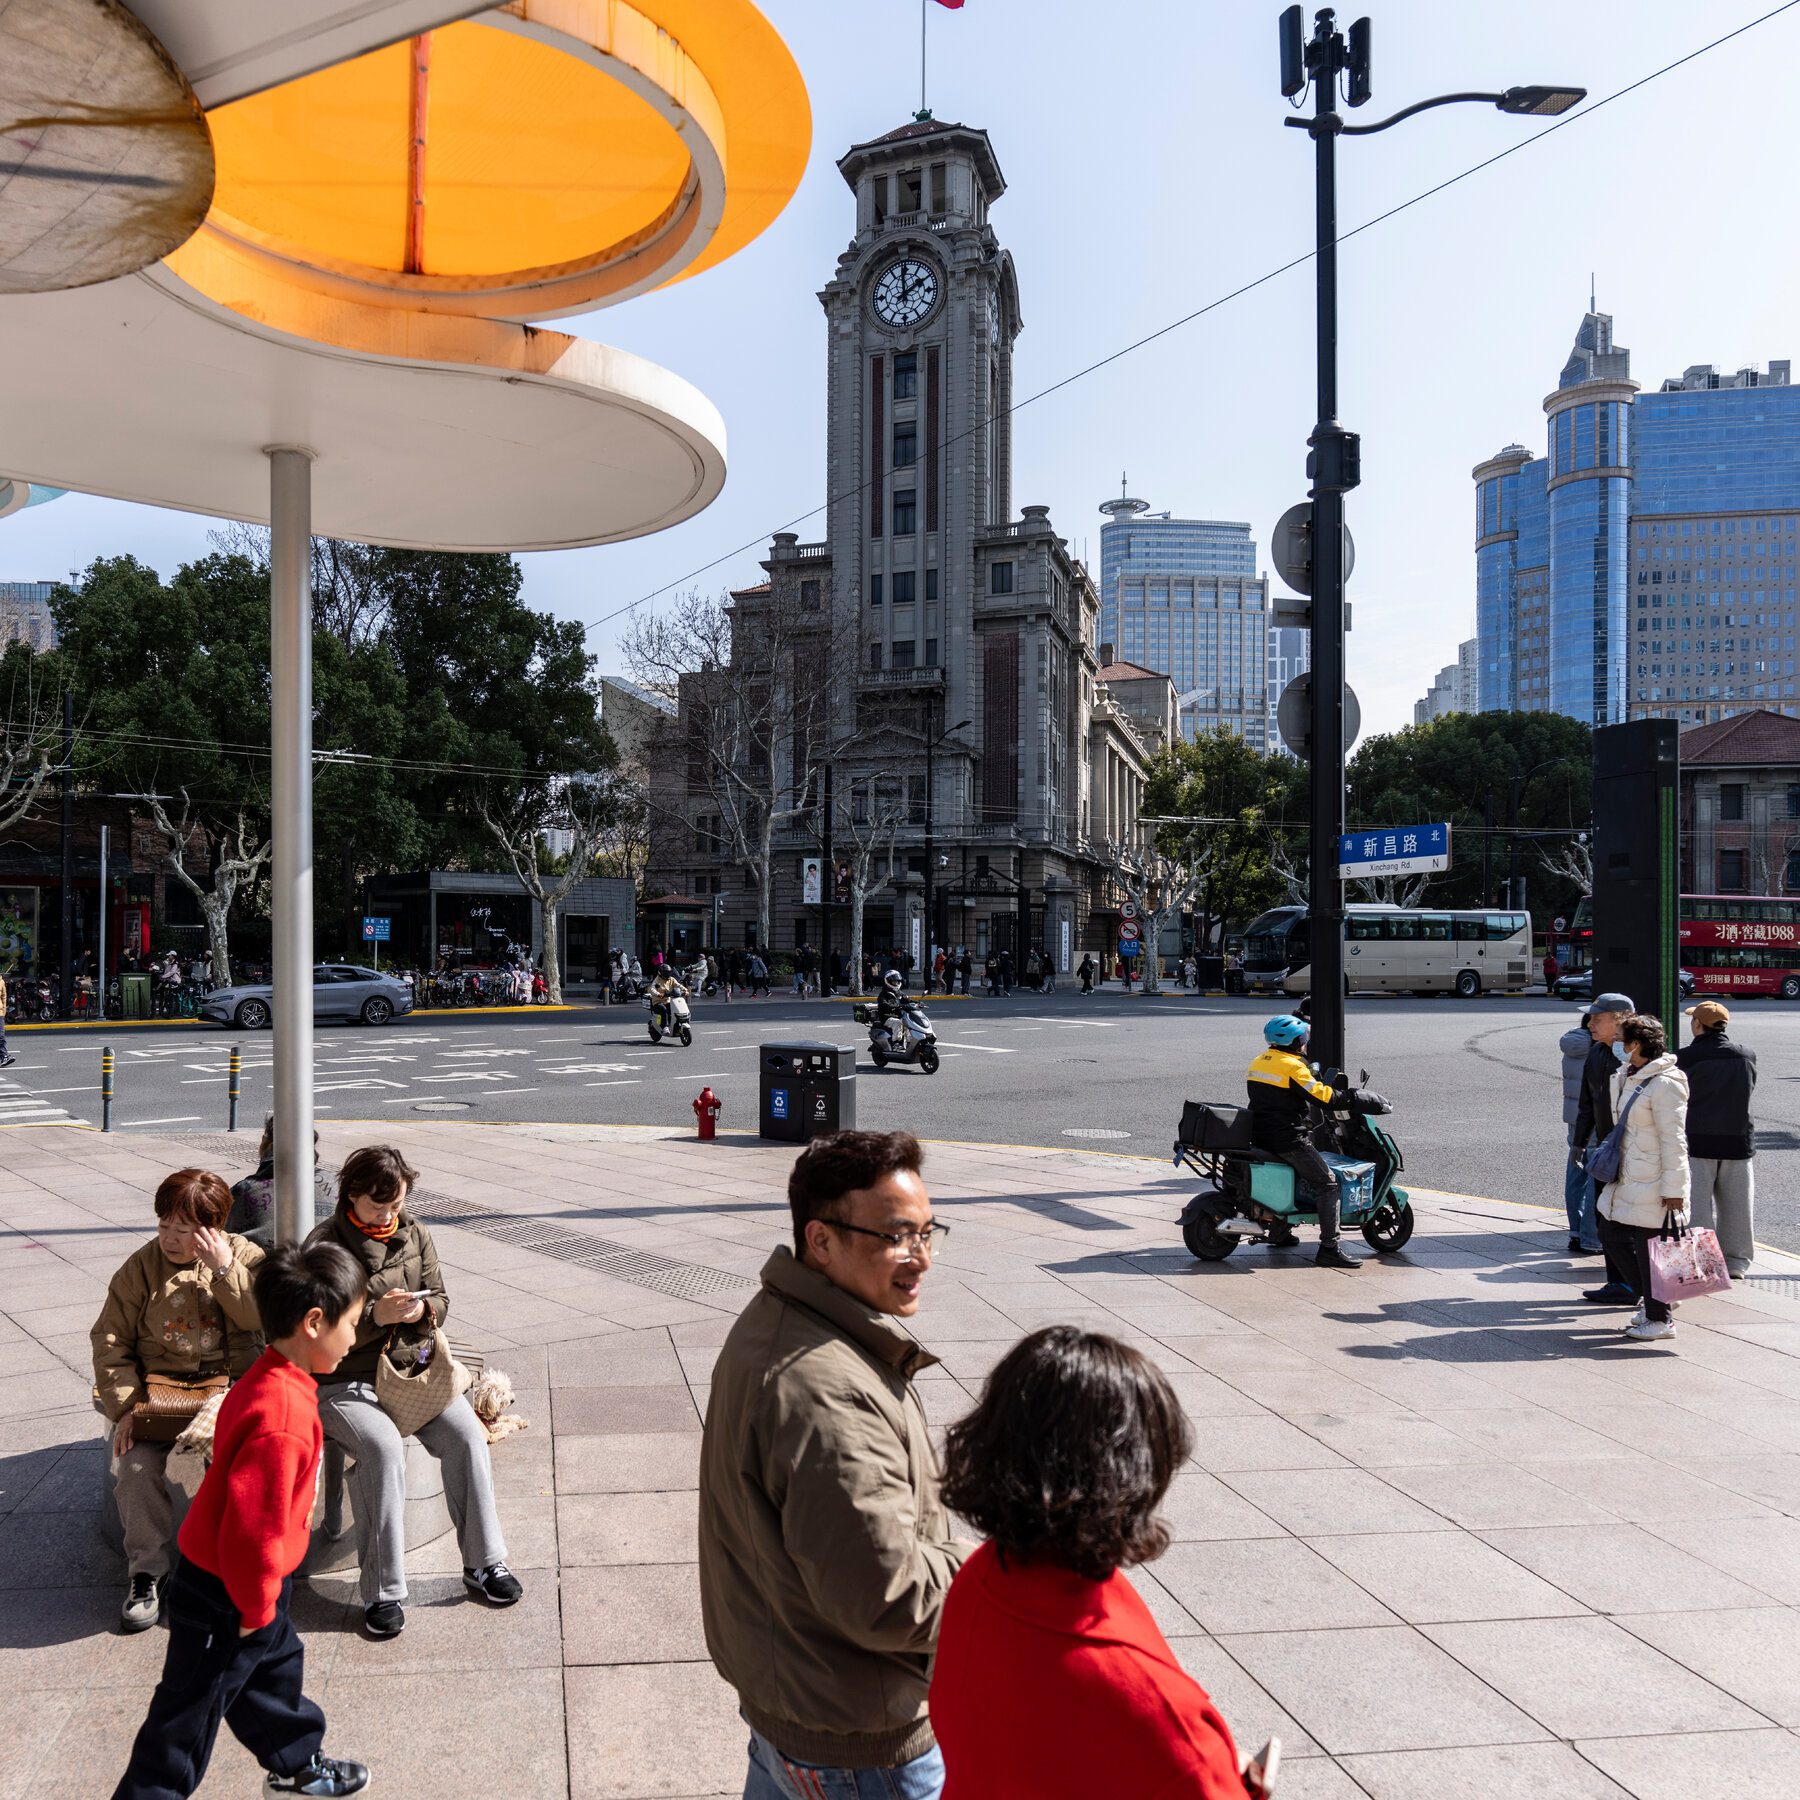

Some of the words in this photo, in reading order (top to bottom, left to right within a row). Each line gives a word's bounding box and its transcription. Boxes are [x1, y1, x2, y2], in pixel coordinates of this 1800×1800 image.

[1345, 840, 1353, 851] 南
[1363, 833, 1418, 857] 新昌路
[1430, 829, 1440, 841] 北
[1346, 866, 1352, 875] S
[1369, 862, 1399, 872] Xinchang
[1401, 861, 1412, 869] Rd.
[1432, 858, 1439, 868] N
[1126, 905, 1134, 916] 5
[1714, 924, 1795, 941] 习酒·窖藏1988
